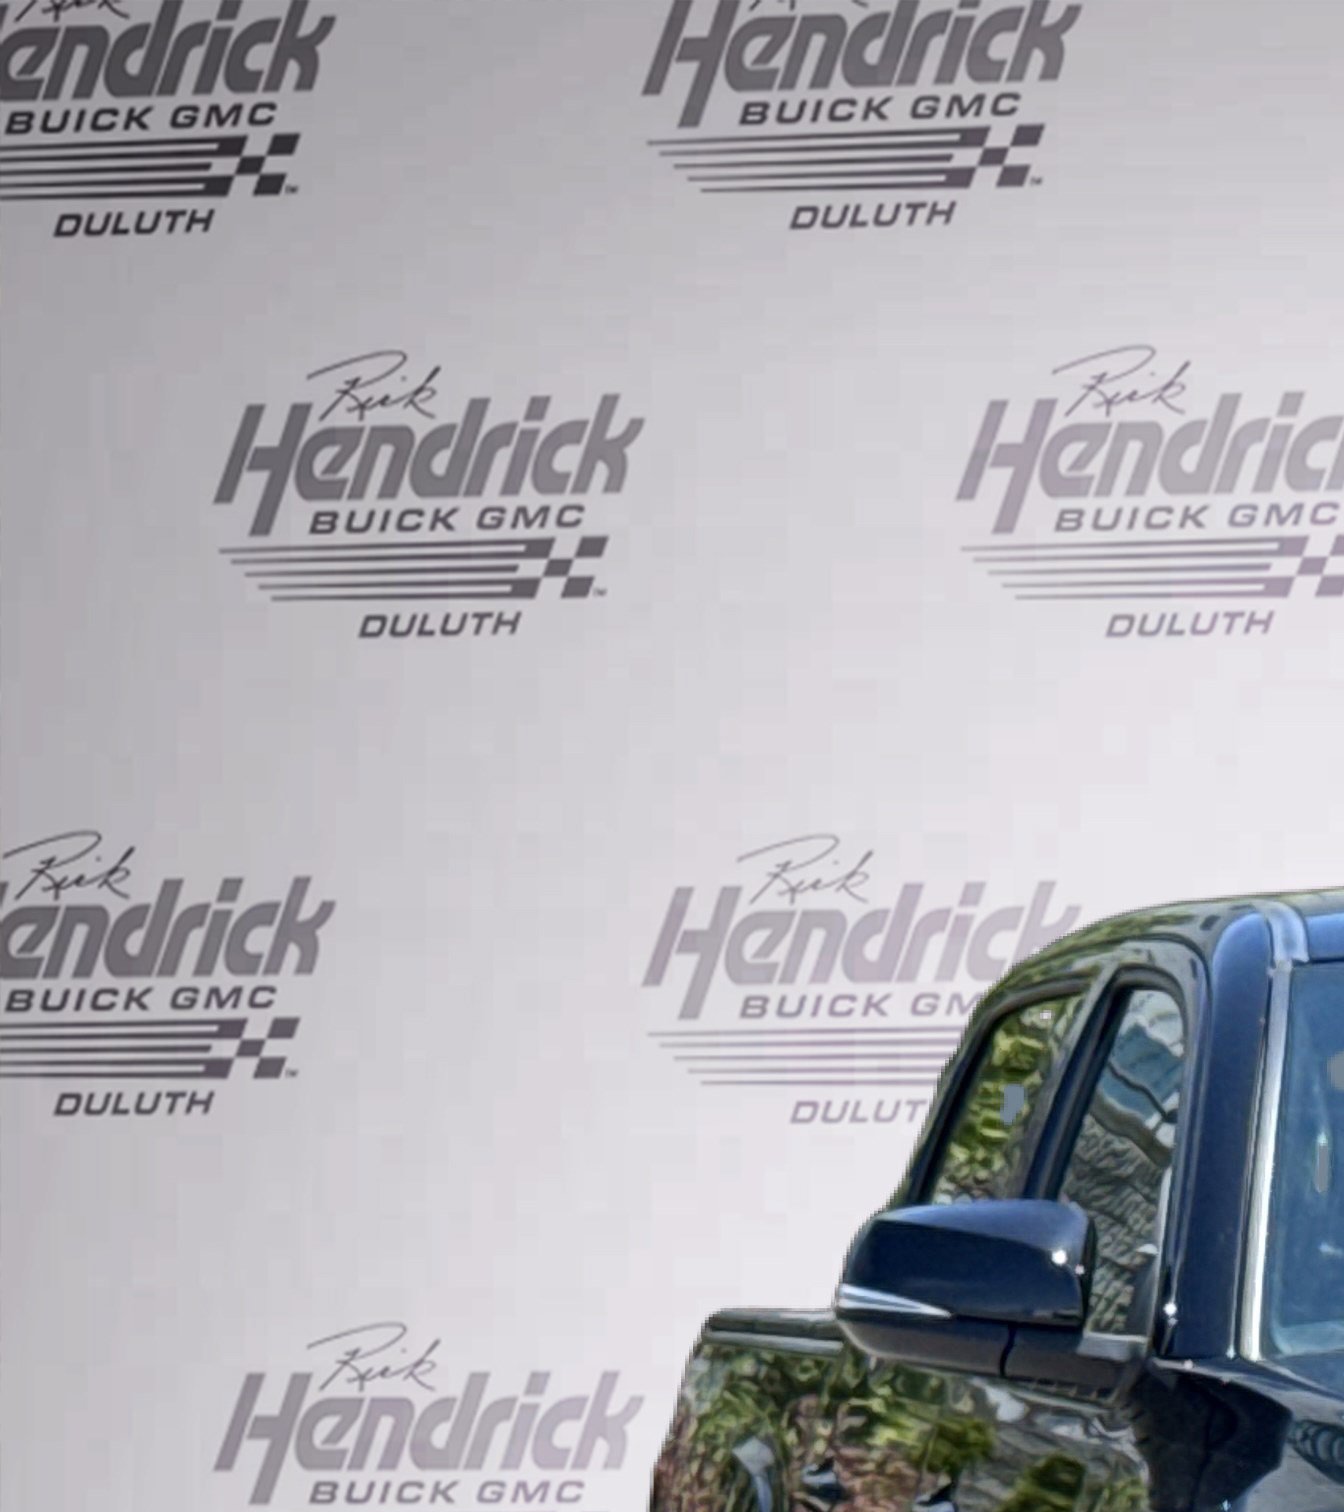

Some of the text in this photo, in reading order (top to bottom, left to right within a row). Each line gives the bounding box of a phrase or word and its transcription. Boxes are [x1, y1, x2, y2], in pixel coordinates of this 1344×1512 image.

[0, 0, 336, 102] endrick
[641, 0, 1082, 128] Hendrick
[5, 102, 277, 134] BUICK GMC
[739, 92, 1022, 126] BUICK GMC
[53, 209, 214, 238] DULUTH
[789, 201, 956, 231] DULUTH
[213, 394, 645, 536] Hendrick
[309, 504, 586, 536] BUICK GMC
[1054, 502, 1341, 533] BUICK GMC
[358, 611, 521, 638] DULUTH
[1105, 611, 1275, 638] DULUTH
[0, 876, 336, 979] endrick
[5, 986, 277, 1012] BUICK GMC
[739, 992, 978, 1019] BUICK GM
[54, 1091, 215, 1115] DULUTH
[790, 1100, 928, 1124] DULUT
[213, 1368, 644, 1505] Hendrick
[308, 1478, 586, 1504] BUICK GMC
